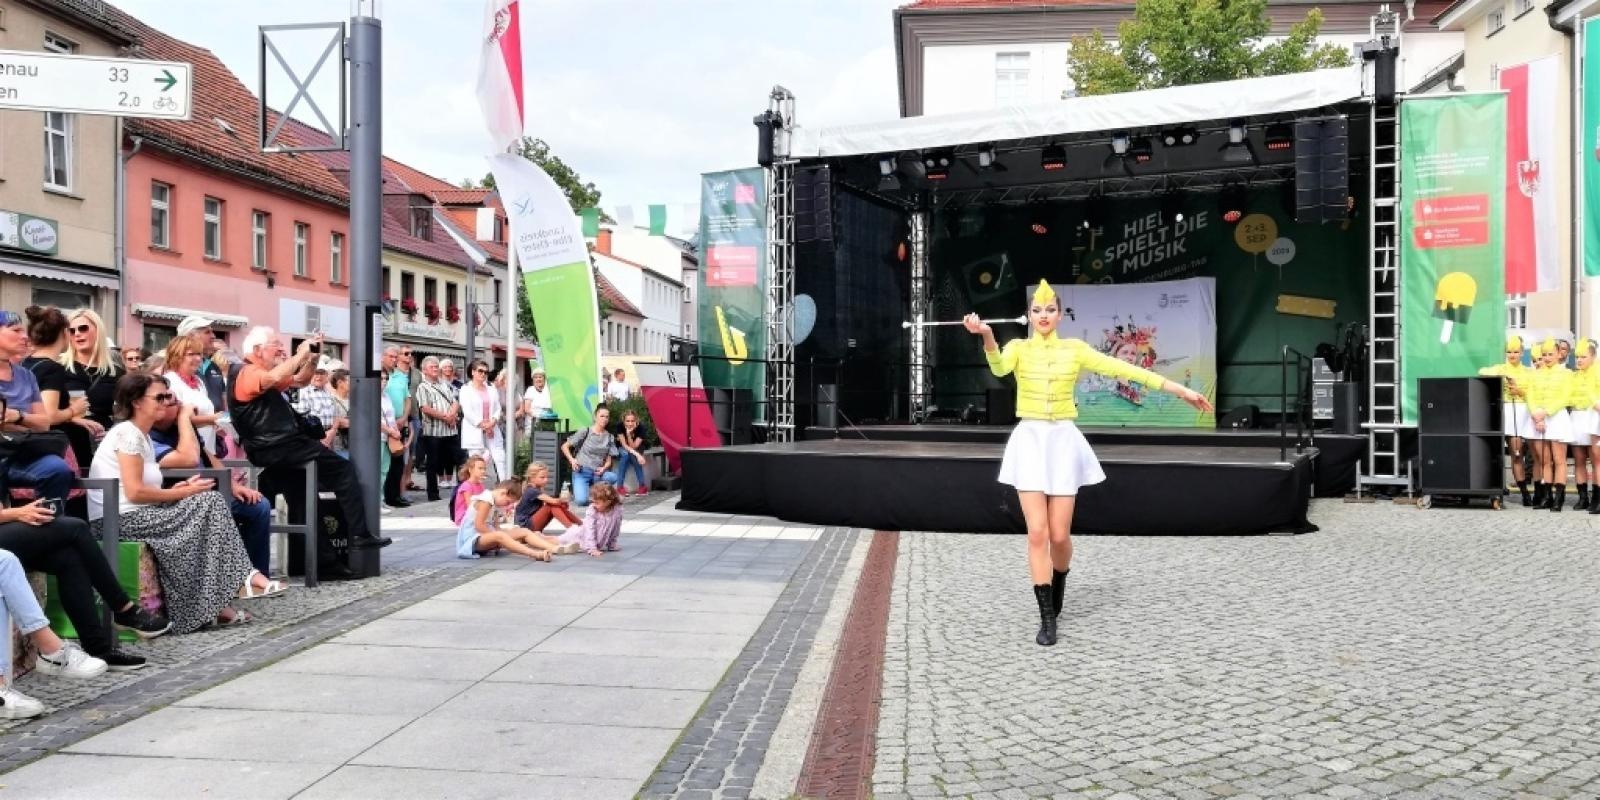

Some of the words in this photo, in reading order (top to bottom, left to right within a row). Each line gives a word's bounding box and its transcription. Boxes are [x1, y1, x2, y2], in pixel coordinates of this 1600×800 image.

[108, 66, 129, 83] 33
[1105, 226, 1169, 263] SPIELT
[1175, 211, 1208, 237] DIE
[1123, 237, 1186, 274] MUSIK
